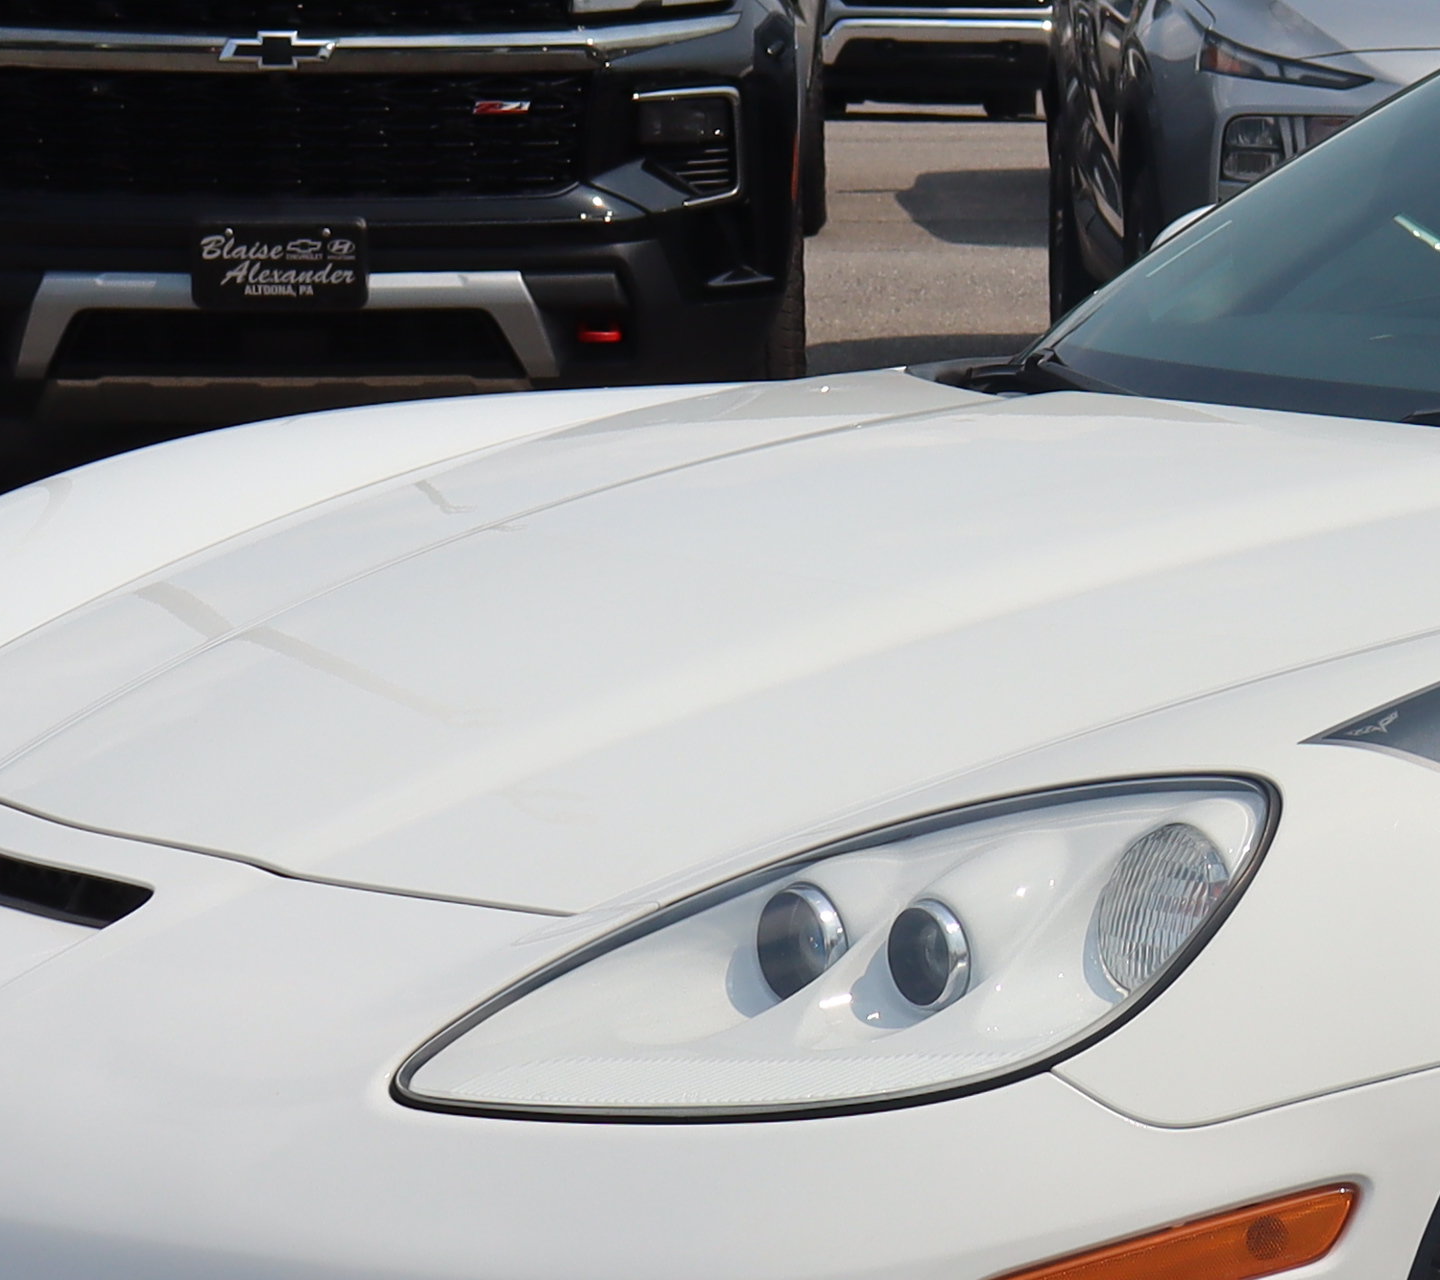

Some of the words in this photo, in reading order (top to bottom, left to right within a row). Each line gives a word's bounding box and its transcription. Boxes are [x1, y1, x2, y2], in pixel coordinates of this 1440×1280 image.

[200, 234, 285, 260] Blaise
[220, 260, 356, 286] Alexander
[244, 284, 297, 297] ALTOONA,
[299, 284, 314, 296] PA
